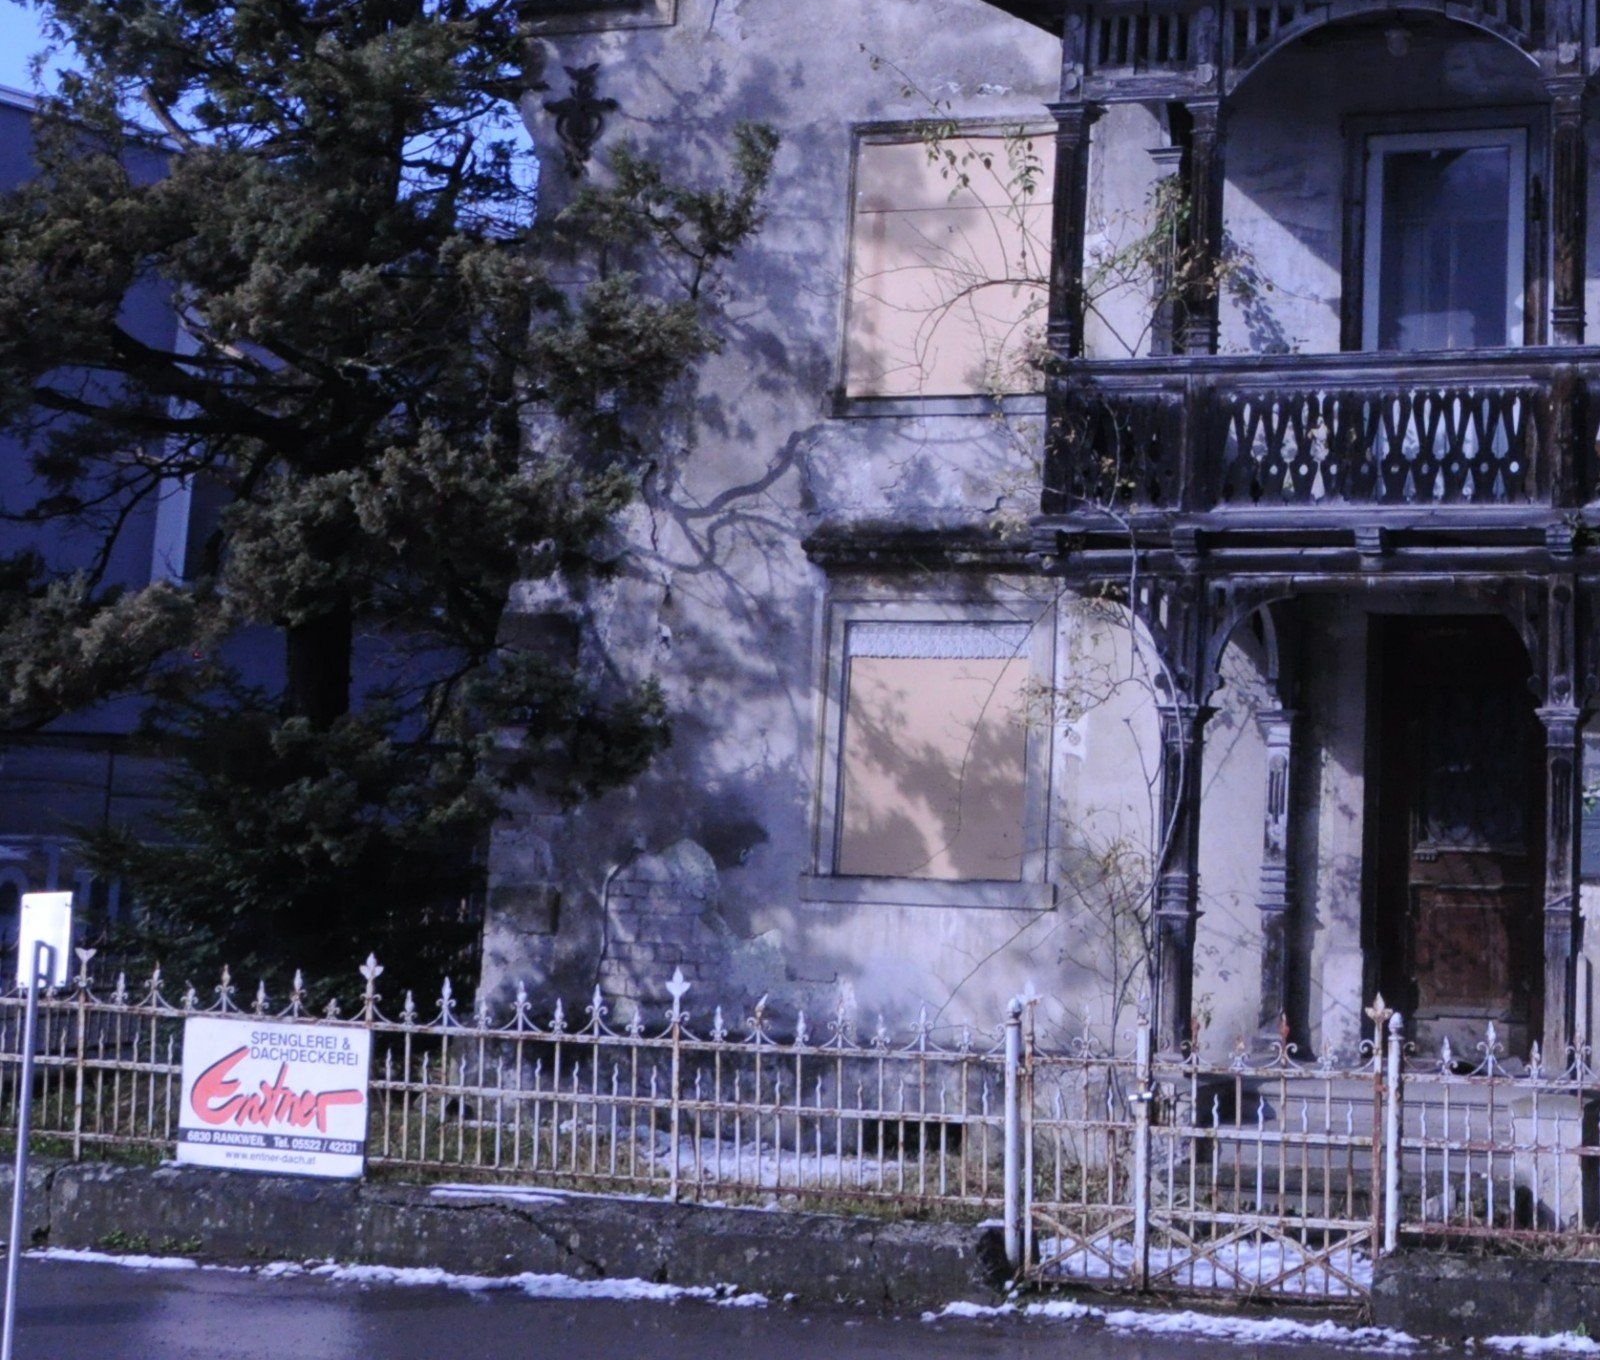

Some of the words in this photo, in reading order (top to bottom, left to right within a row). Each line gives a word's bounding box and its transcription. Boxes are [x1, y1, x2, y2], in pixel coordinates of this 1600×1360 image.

[251, 1031, 337, 1049] SPENGLEREI
[342, 1037, 351, 1050] &
[250, 1046, 358, 1066] DACHDECKEREI
[190, 1045, 364, 1133] Entner
[187, 1130, 211, 1143] 6830
[213, 1132, 266, 1147] RANKWEIL
[273, 1136, 289, 1148] Tel.
[292, 1138, 321, 1151] 05522
[328, 1141, 357, 1154] 42331
[225, 1150, 316, 1165] www.entner-dach.at
